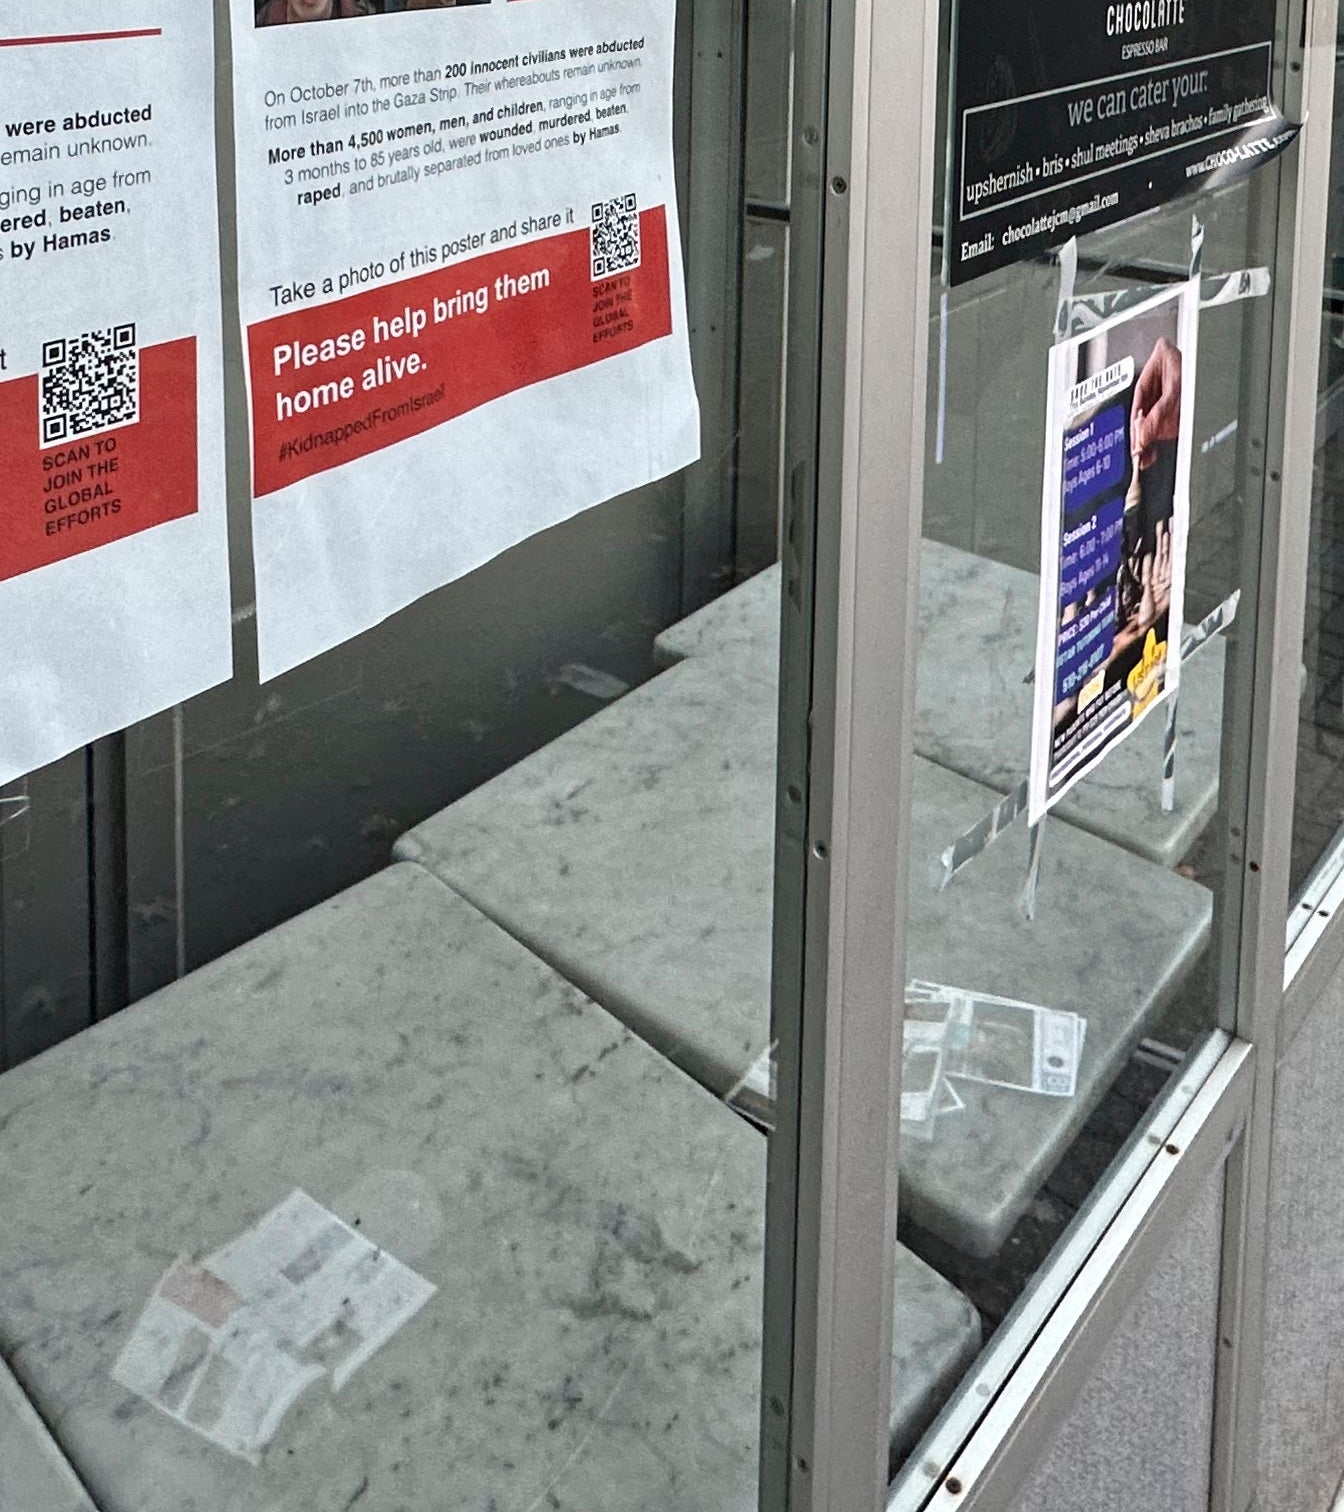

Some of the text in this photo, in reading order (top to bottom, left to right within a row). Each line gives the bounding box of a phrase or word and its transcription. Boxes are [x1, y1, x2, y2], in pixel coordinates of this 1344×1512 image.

[1121, 36, 1169, 60] ESPRESSO BAR
[1067, 98, 1093, 127] we
[1096, 90, 1127, 118] can
[1129, 80, 1170, 112] cater
[5, 117, 57, 139] were
[62, 104, 153, 132] abducted
[67, 131, 153, 158] unknown.
[966, 163, 1034, 204] upshernish
[1042, 154, 1064, 178] bris
[1071, 143, 1094, 169] shul
[1095, 132, 1139, 161] meetings
[1144, 123, 1170, 147] sheva
[1171, 113, 1204, 139] brachos
[1206, 103, 1233, 126] family
[47, 180, 65, 198] in
[71, 176, 107, 199] age
[111, 168, 152, 189] from
[59, 197, 132, 224] beaten,
[10, 238, 36, 260] by
[961, 236, 996, 262] Email:
[273, 267, 550, 376] Please help bring them
[276, 352, 427, 421] home alive.
[278, 383, 447, 463] #KidnappedFromIsrael
[42, 437, 117, 471] SCAN TO
[43, 457, 119, 493] JOIN THE
[44, 482, 114, 514] GLOBAL
[45, 498, 121, 537] EFFORTS
